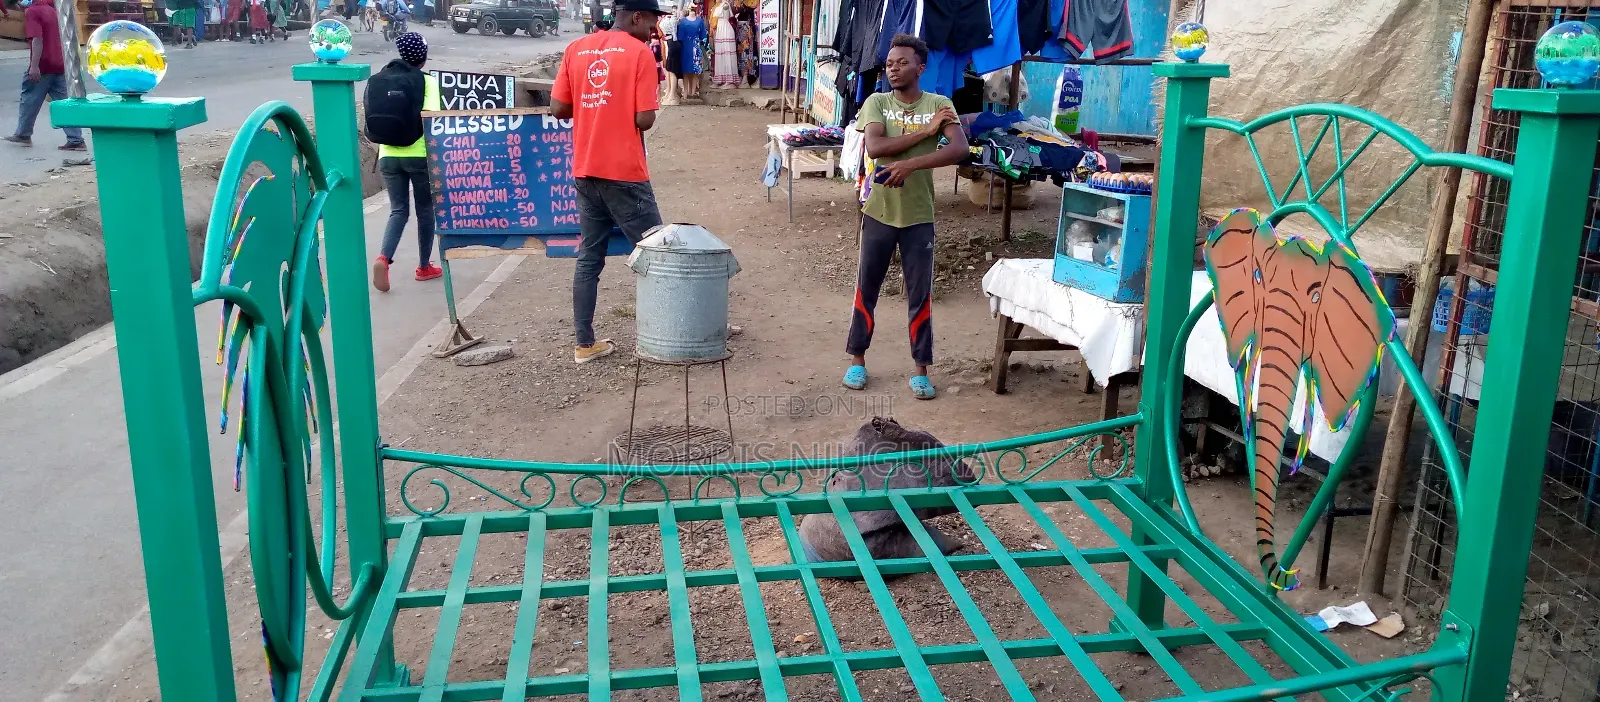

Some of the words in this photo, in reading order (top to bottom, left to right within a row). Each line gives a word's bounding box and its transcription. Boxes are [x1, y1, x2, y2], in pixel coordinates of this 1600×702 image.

[441, 72, 499, 92] DUKA
[454, 89, 478, 98] LA
[431, 115, 523, 135] BLESSED
[443, 135, 476, 148] CHAI
[507, 133, 521, 145] 20
[442, 149, 480, 162] CHAPO
[508, 147, 521, 159] 10
[445, 161, 494, 176] ANDAZI
[510, 159, 521, 172] 5
[509, 173, 526, 185] 30
[448, 188, 507, 204] NGWACHI
[514, 188, 529, 199] 20
[450, 205, 486, 218] PILAU
[517, 202, 535, 213] 50
[452, 217, 509, 229] MUKIMO
[520, 216, 538, 227] 50
